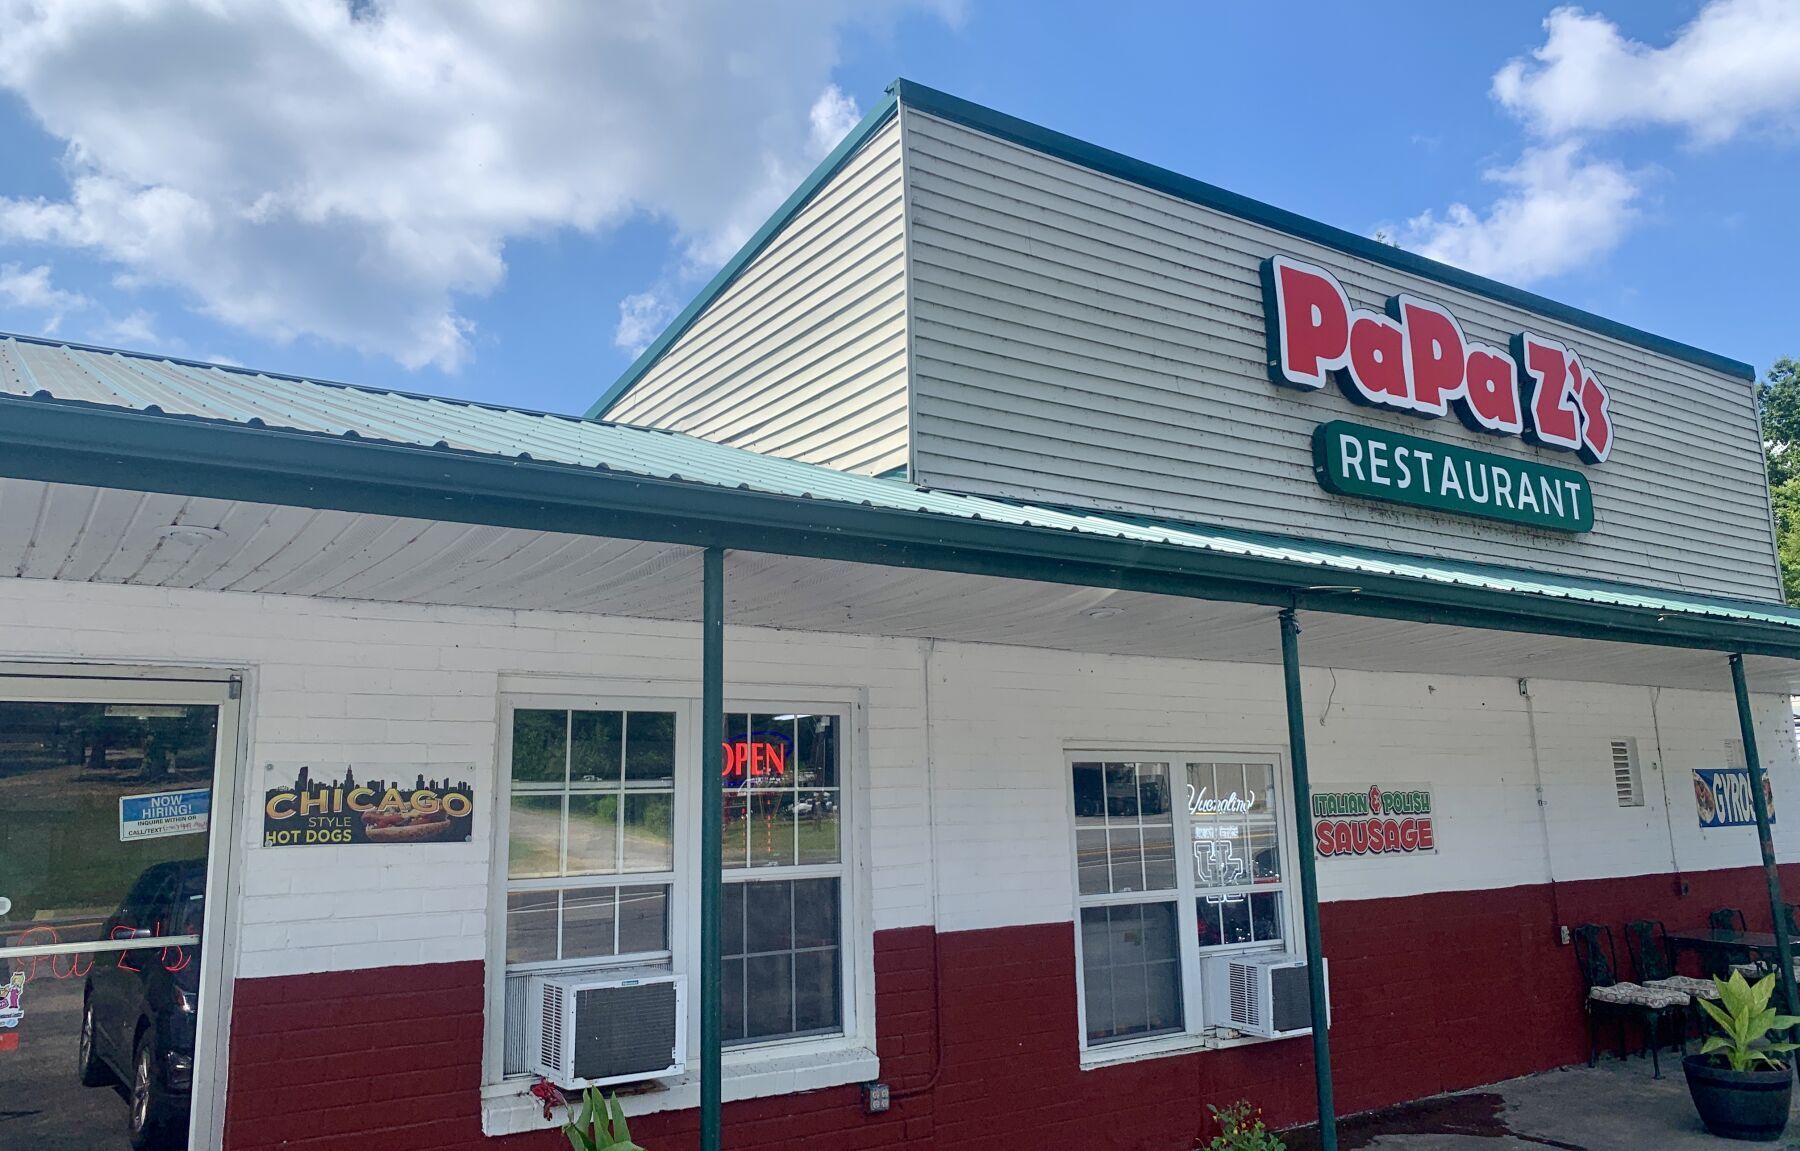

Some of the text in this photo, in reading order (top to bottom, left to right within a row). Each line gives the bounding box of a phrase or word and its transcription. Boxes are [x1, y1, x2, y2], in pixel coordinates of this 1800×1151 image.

[1339, 434, 1582, 521] RESTAURANT
[151, 795, 182, 808] NOW
[266, 787, 473, 820] CHICAGO
[1313, 785, 1431, 816] ITALIAN & POLISH
[142, 804, 192, 819] HIRING!
[165, 816, 186, 824] WITHIN
[308, 816, 352, 828] STYLE
[128, 827, 162, 836] CALL/TEXT
[265, 829, 352, 845] HOT DOGS
[1316, 818, 1434, 856] SAUSAGE
